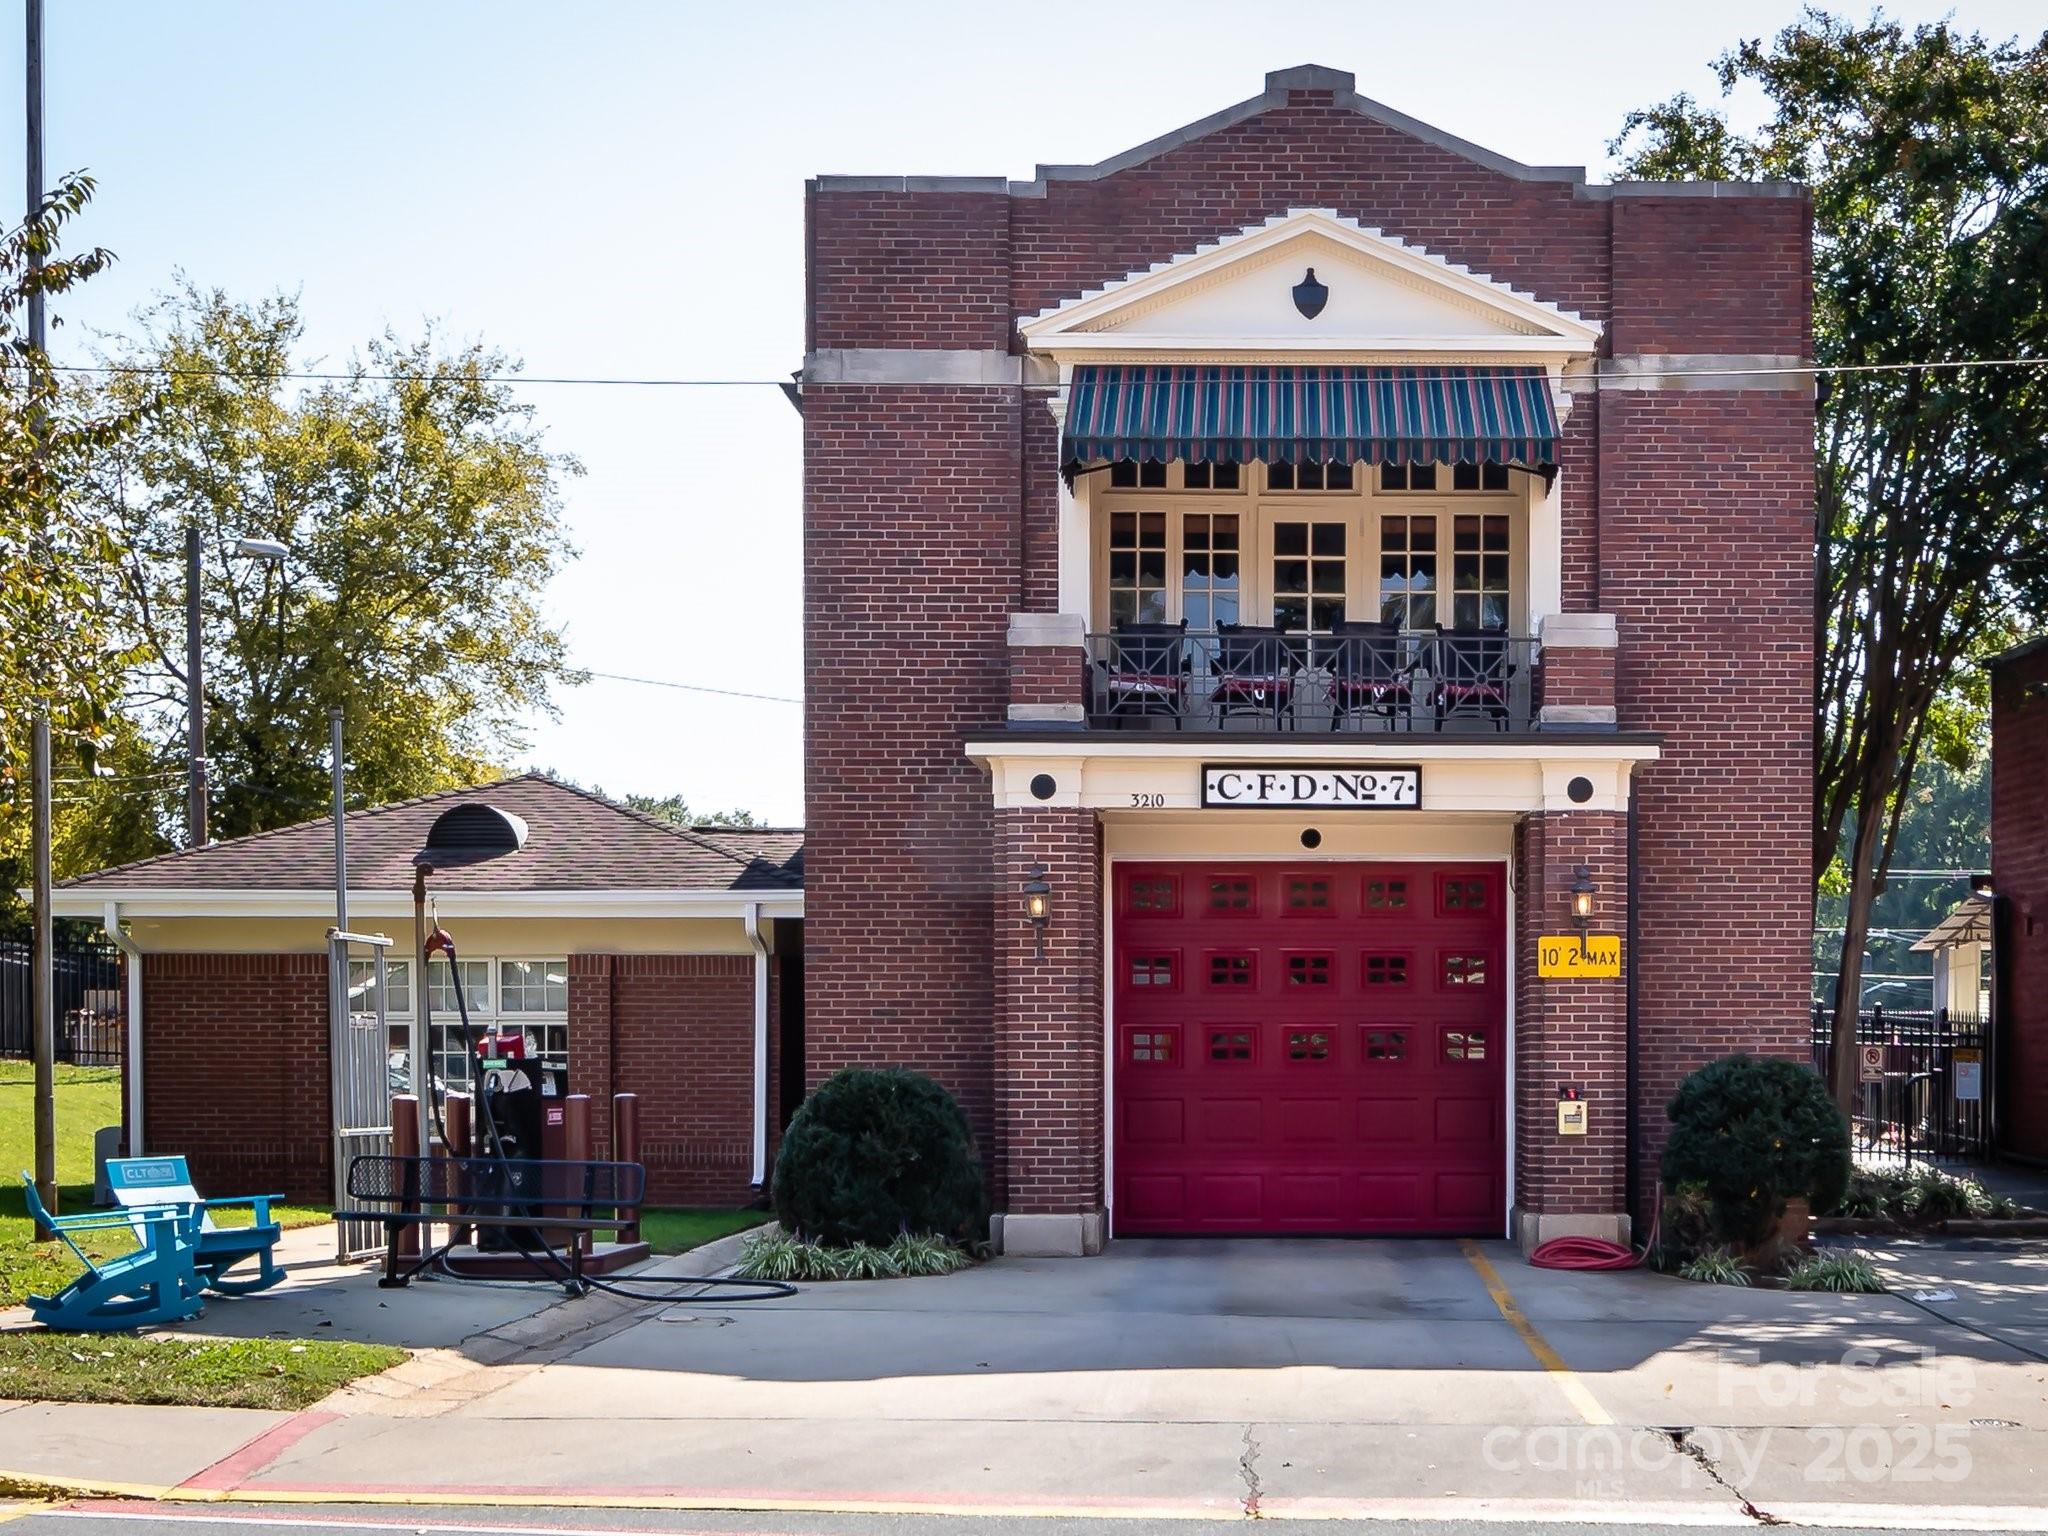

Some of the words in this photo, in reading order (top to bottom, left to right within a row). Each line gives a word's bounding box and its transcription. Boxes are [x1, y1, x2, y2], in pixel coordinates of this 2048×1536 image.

[1131, 794, 1165, 808] 3210
[1543, 947, 1561, 966] 10'
[1587, 951, 1617, 965] MAX
[127, 1168, 147, 1178] CLT
